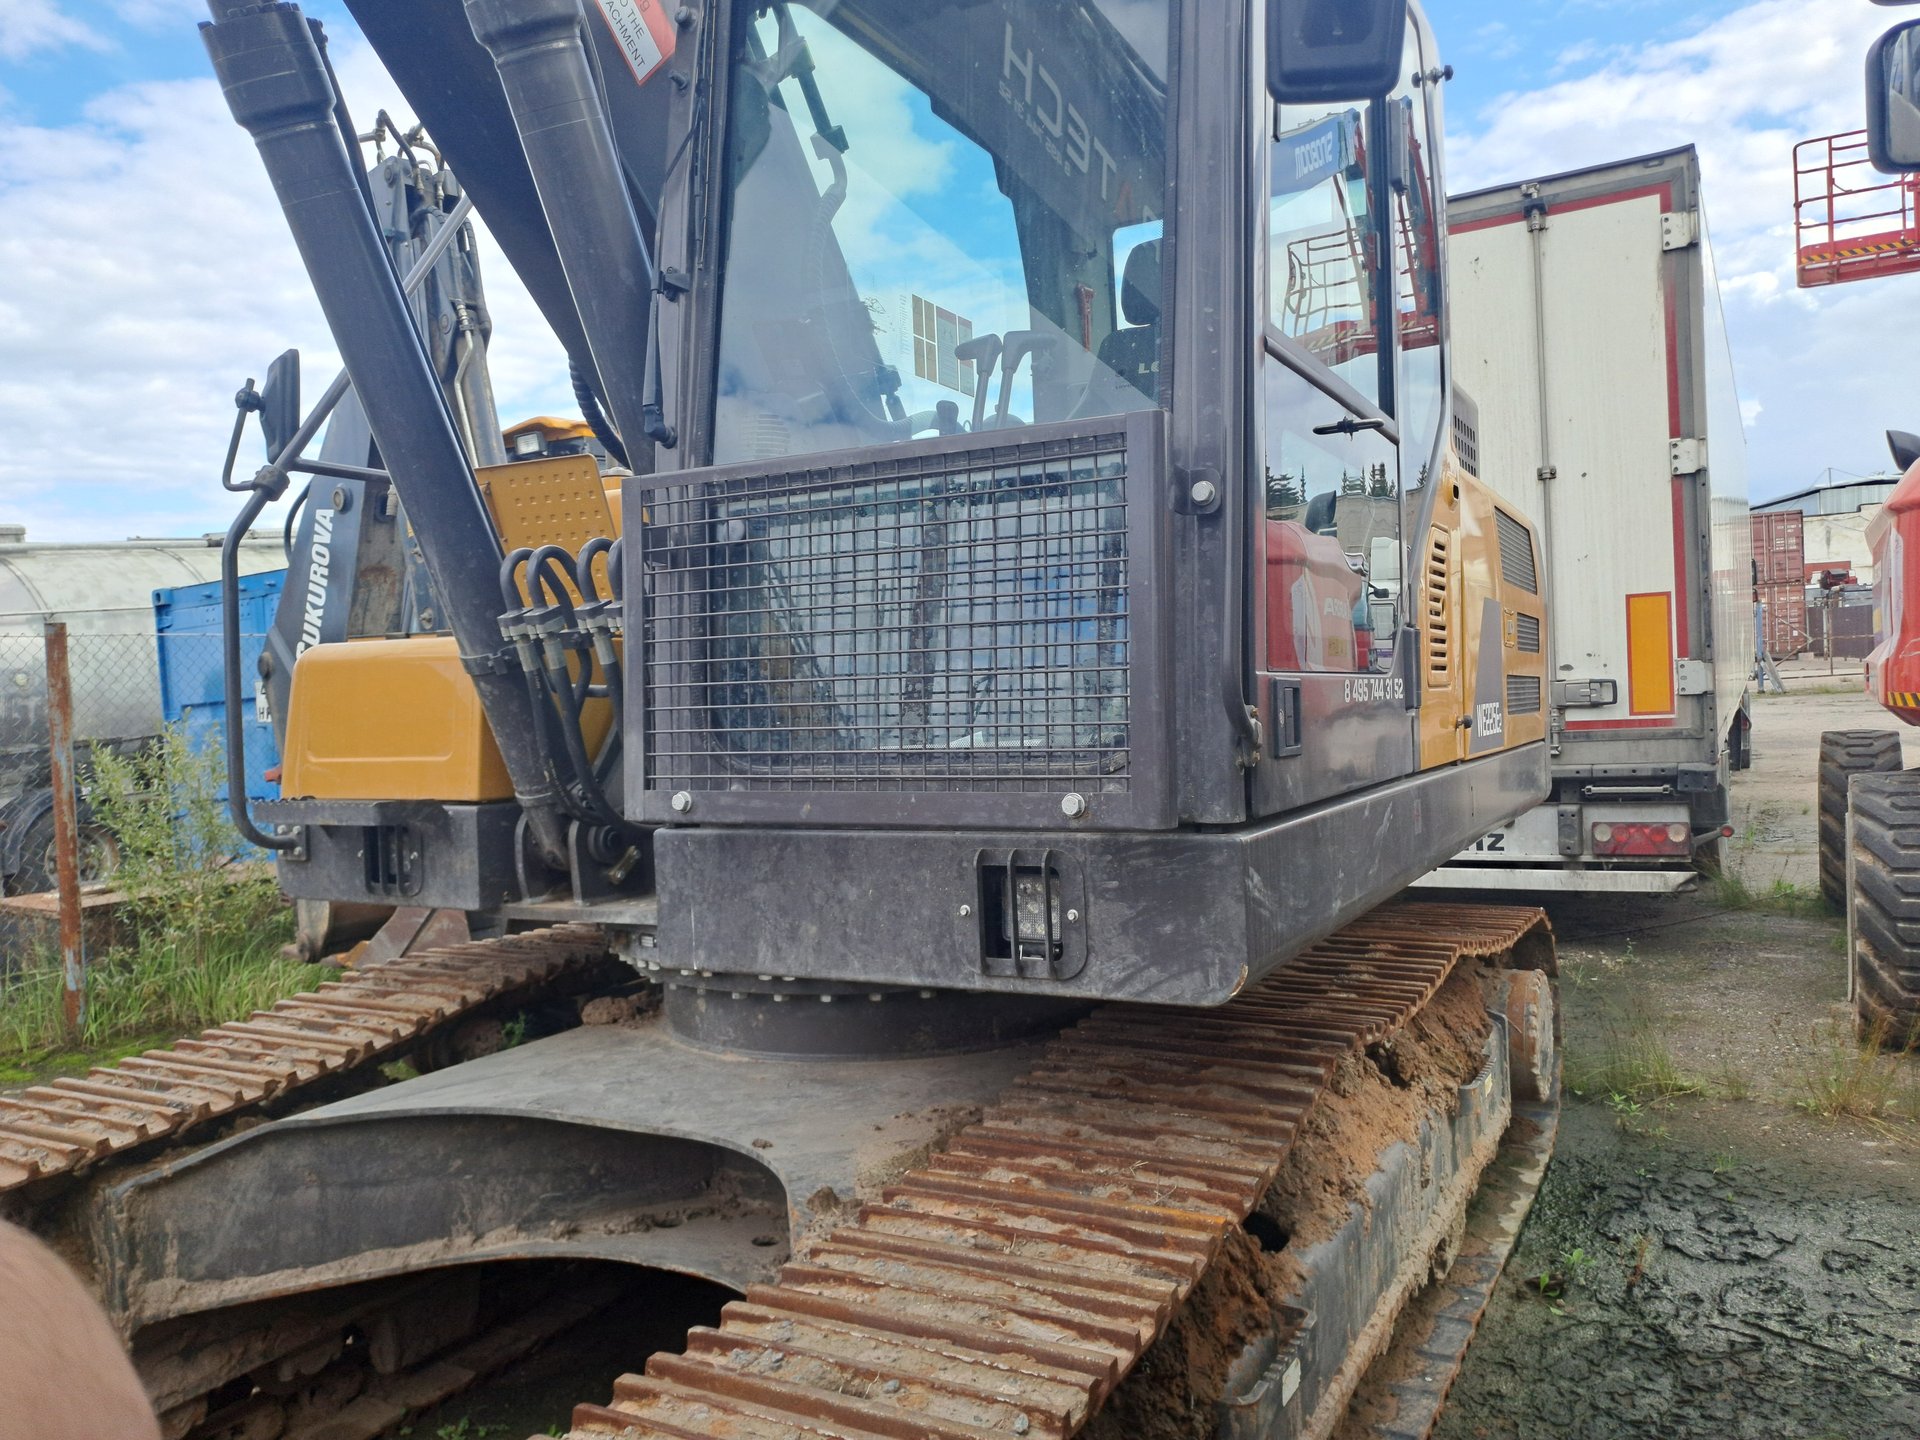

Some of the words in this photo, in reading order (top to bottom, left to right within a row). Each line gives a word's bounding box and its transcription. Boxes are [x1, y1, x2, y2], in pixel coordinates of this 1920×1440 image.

[606, 1, 646, 67] ACHMENT
[627, 9, 645, 39] THE
[1344, 679, 1351, 703] 8
[1352, 679, 1369, 702] 495
[1370, 678, 1385, 701] 744
[1394, 677, 1404, 699] 52
